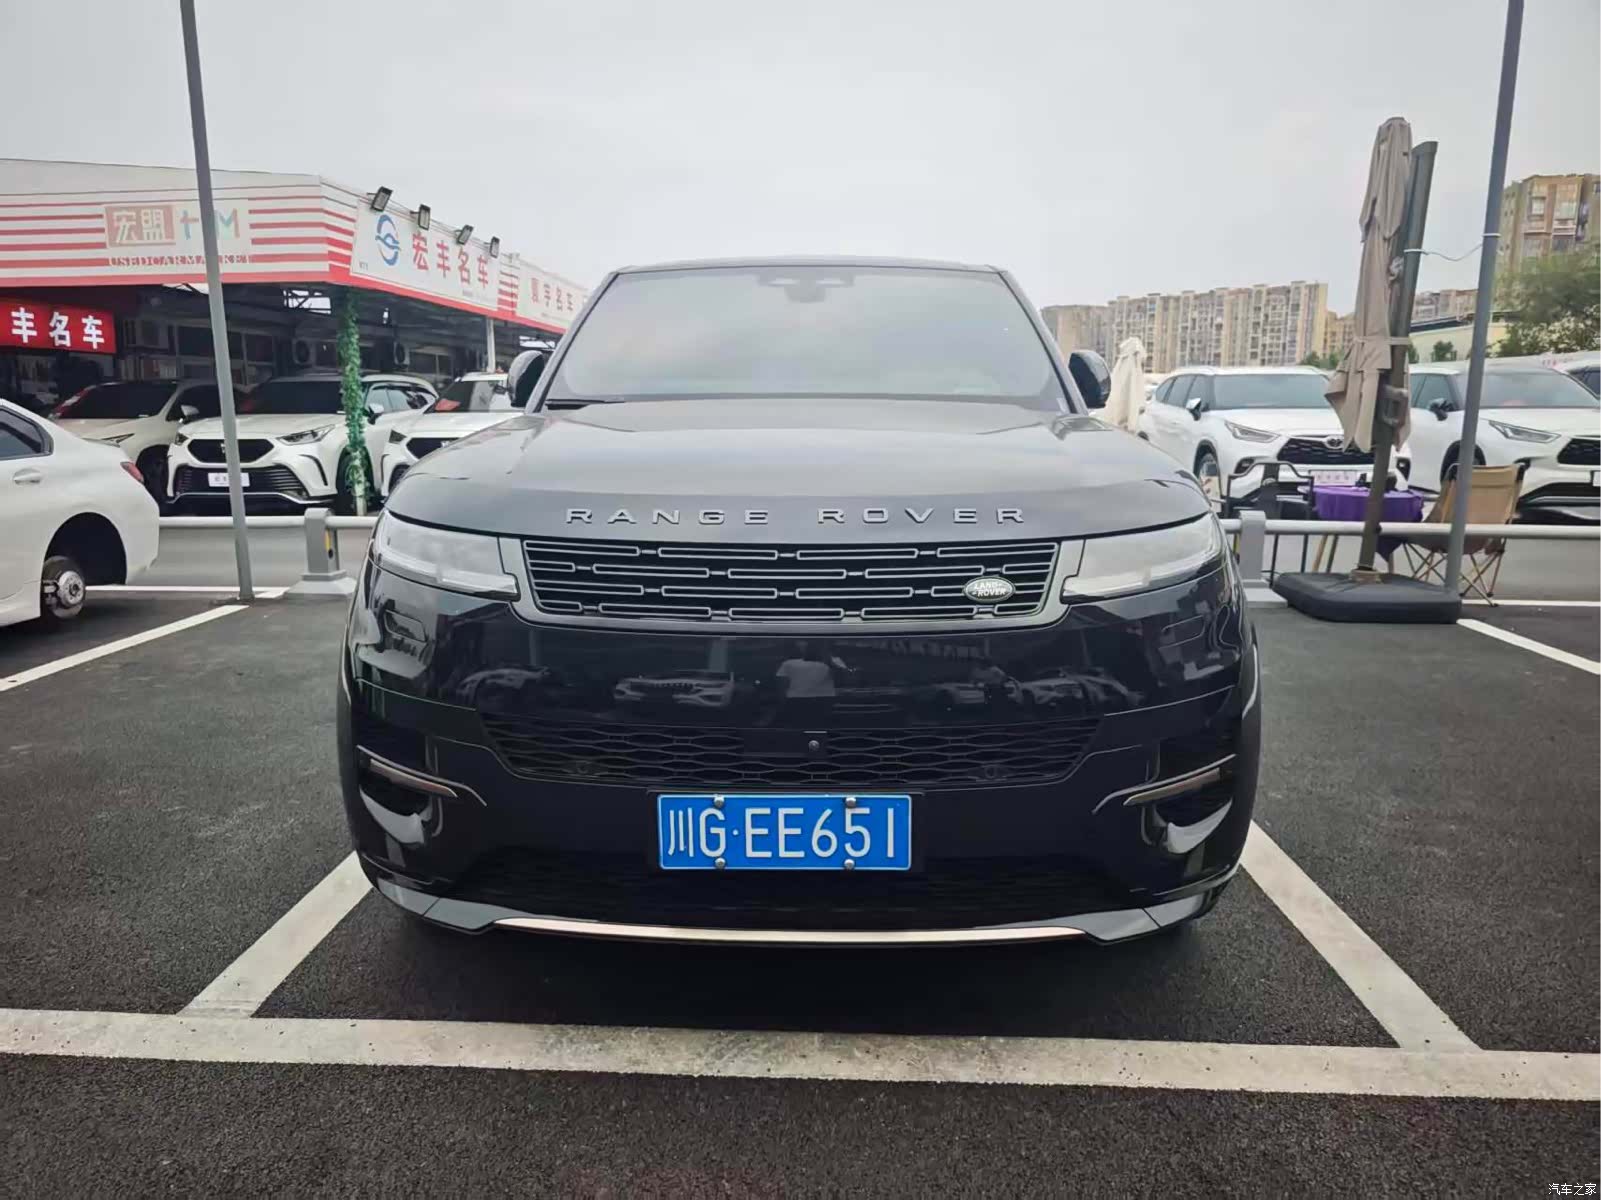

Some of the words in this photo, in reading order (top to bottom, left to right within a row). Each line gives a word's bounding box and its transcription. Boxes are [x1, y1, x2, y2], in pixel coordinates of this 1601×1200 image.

[112, 208, 164, 244] 宏盟
[411, 231, 489, 290] 宏丰名车
[10, 306, 105, 350] 丰名车
[565, 507, 769, 525] RANGE
[817, 507, 1025, 524] ROVER
[977, 587, 1007, 598] ROVER
[667, 807, 895, 858] 川G·EE651
